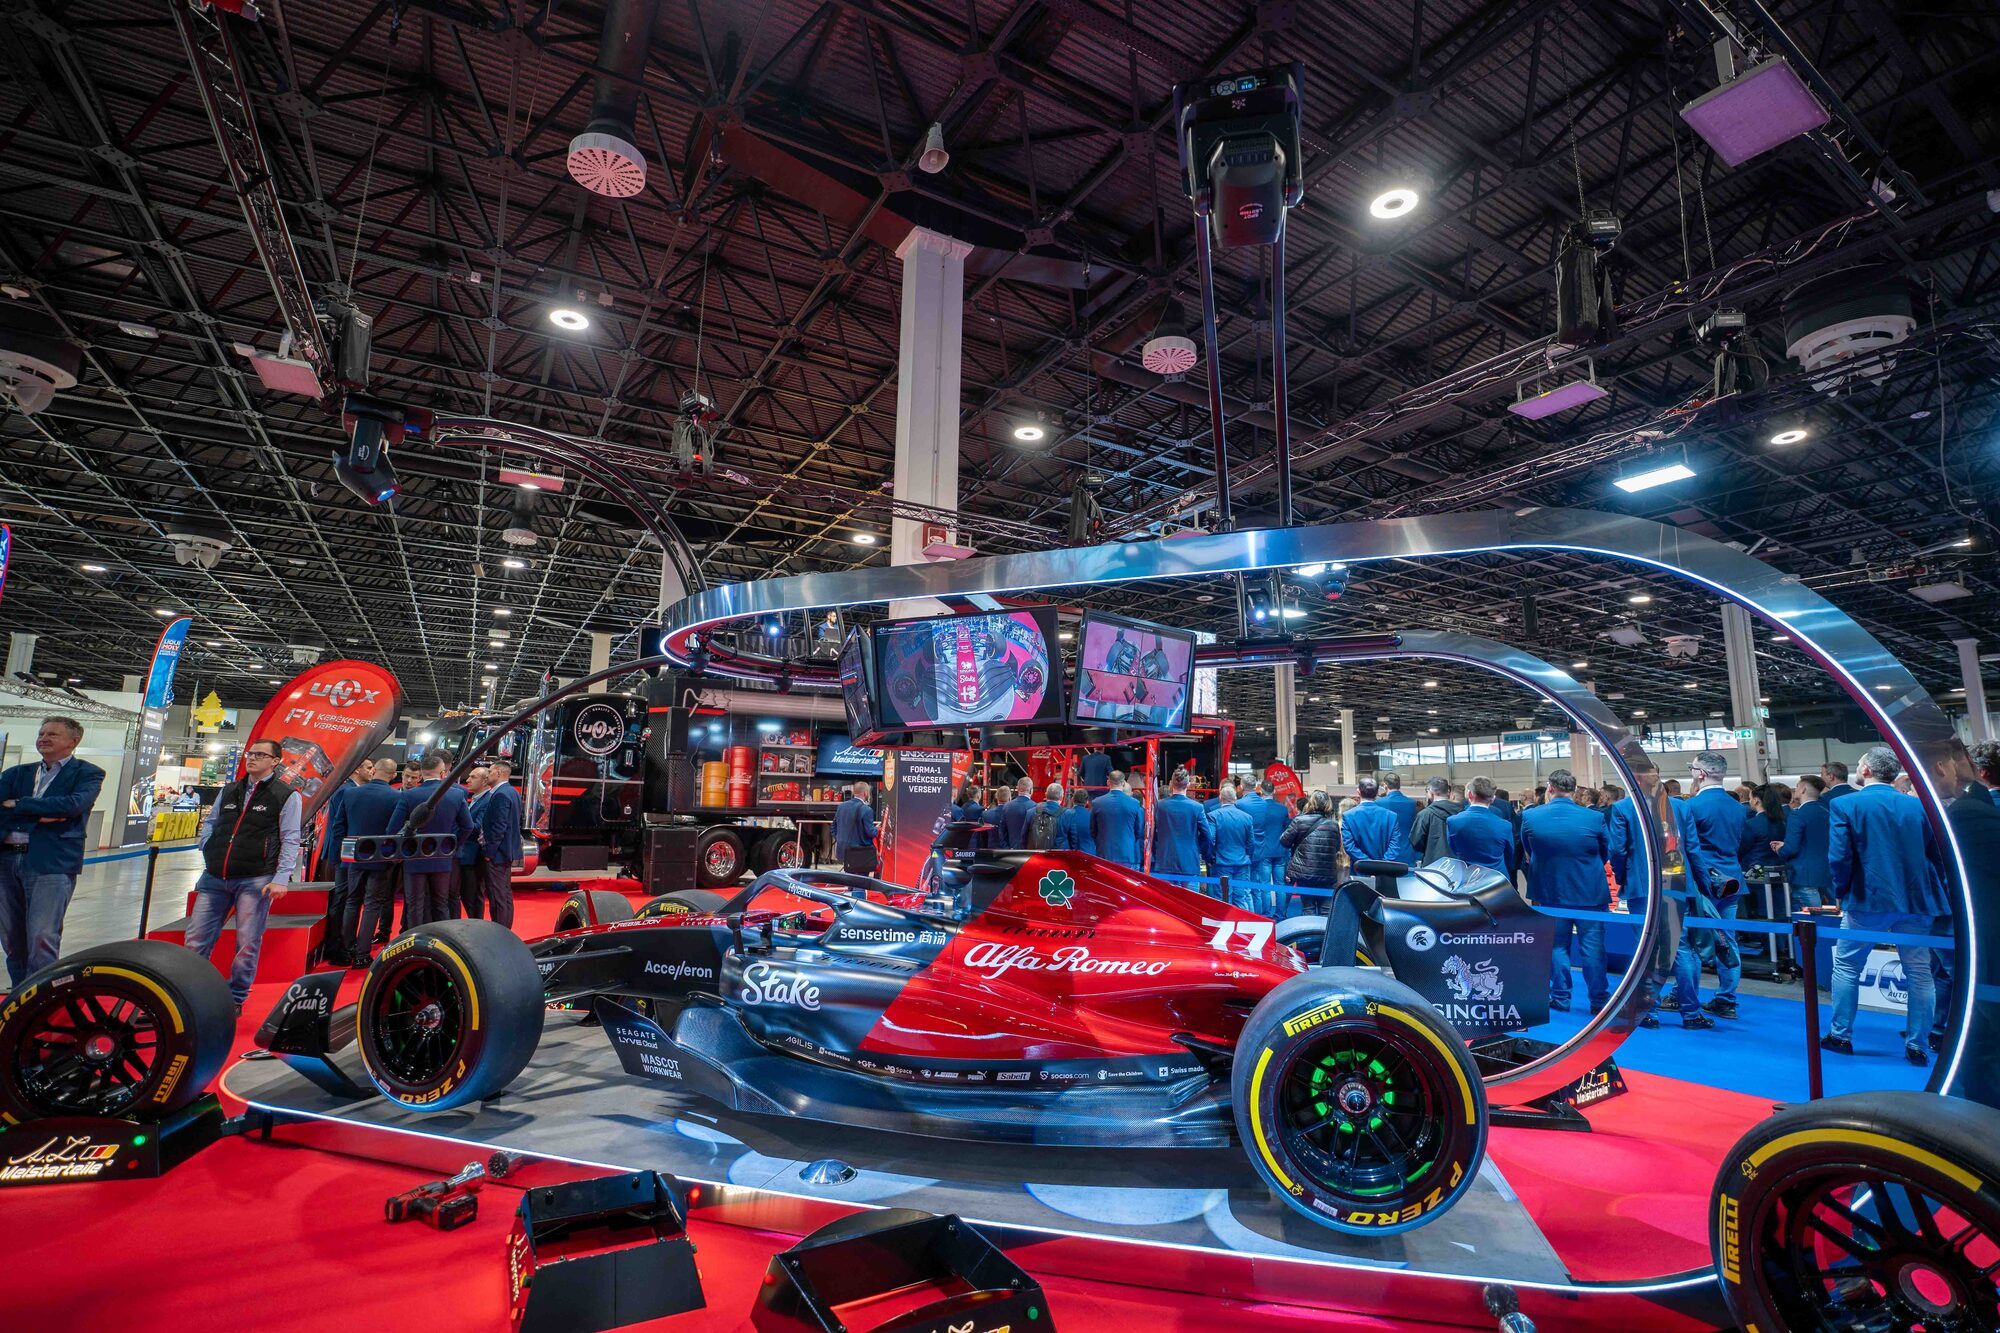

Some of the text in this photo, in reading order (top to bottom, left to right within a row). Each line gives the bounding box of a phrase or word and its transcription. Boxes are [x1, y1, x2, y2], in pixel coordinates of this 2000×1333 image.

[284, 707, 315, 726] F1
[313, 721, 356, 734] VERSENY
[831, 755, 880, 765] Meisterteile
[910, 765, 942, 774] FORMA-1
[902, 774, 948, 784] KERÉKCSERE
[908, 785, 942, 793] VERSENY
[840, 927, 947, 946] sensetime 商汤
[1202, 916, 1275, 959] 77
[1440, 932, 1535, 945] CorinthianRe
[382, 933, 416, 962] PIRELLI
[964, 942, 1171, 980] Alfa Romeo
[741, 962, 821, 1012] Stake
[1282, 999, 1345, 1038] PIRELLI
[1433, 1003, 1521, 1020] SINGHA
[616, 1027, 656, 1040] SEAGATE
[618, 1036, 658, 1049] LYVE Cloud
[640, 1053, 679, 1071] MASCOT
[1170, 1067, 1187, 1075] Swiss
[152, 1054, 189, 1103] PIRELLI
[643, 1064, 683, 1080] WORKWEAR
[400, 1076, 454, 1105] ZERO
[0, 1160, 104, 1181] Meisterteile
[1449, 1160, 1463, 1188] P
[1347, 1186, 1445, 1226] ZERO
[1719, 1192, 1741, 1285] PIRELLI
